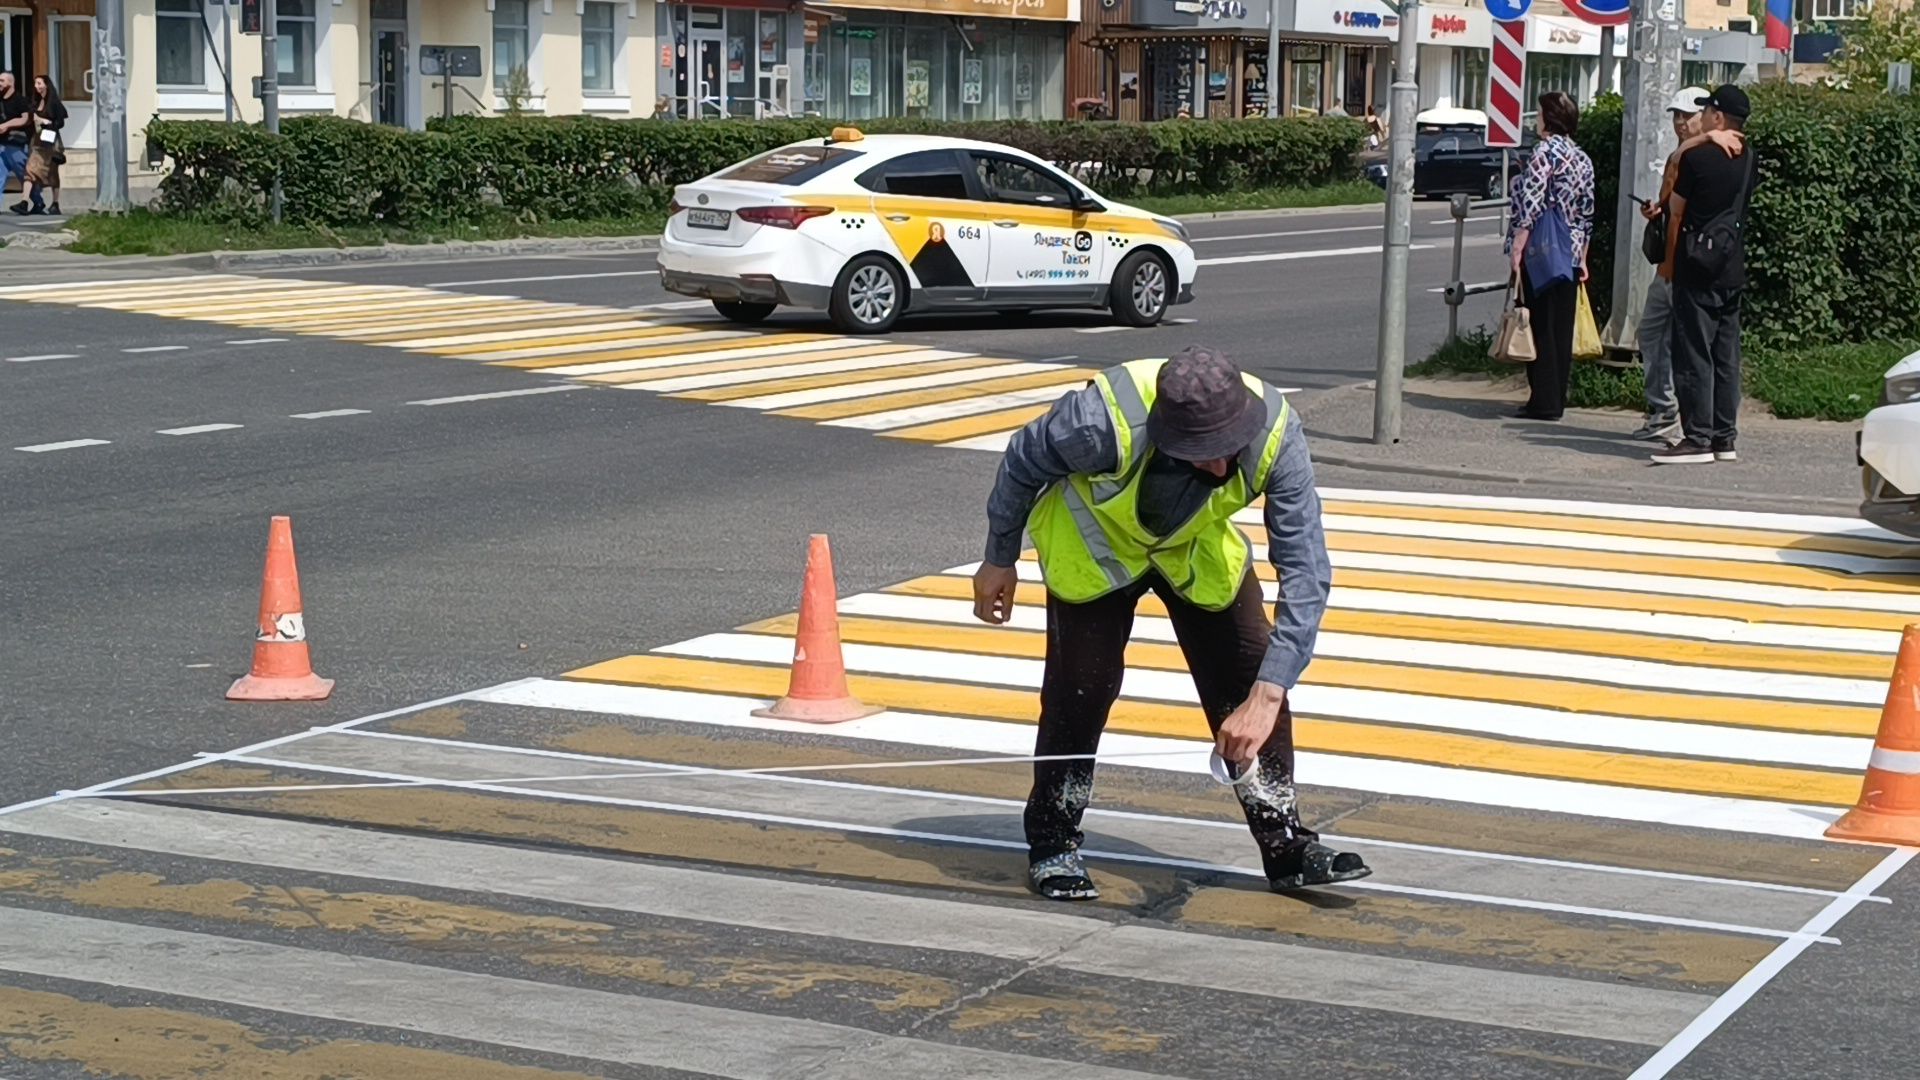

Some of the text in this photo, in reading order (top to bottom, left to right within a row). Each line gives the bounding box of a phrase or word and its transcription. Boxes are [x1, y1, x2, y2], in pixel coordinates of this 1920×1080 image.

[958, 225, 981, 240] 664
[1033, 232, 1091, 249] Яндекс Go
[1062, 251, 1091, 265] Такси
